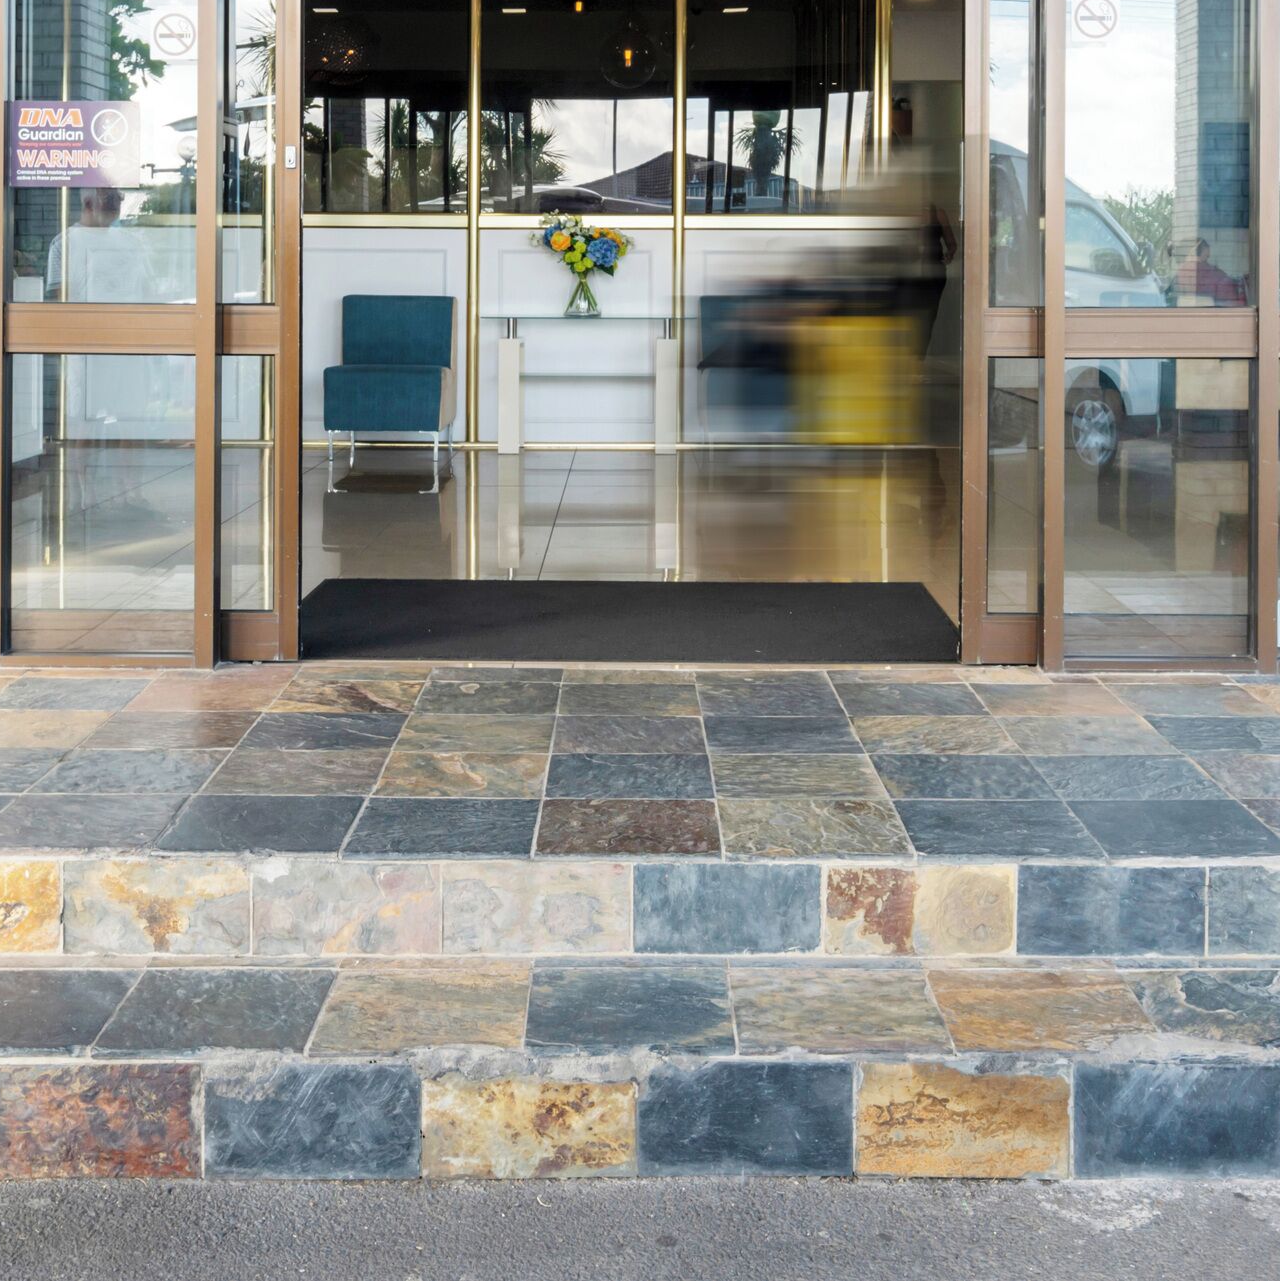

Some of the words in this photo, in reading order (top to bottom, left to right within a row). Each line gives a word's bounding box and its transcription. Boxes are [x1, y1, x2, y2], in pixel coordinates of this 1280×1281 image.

[18, 107, 84, 128] DNA
[18, 128, 84, 141] Guardian
[16, 149, 116, 168] WARNING
